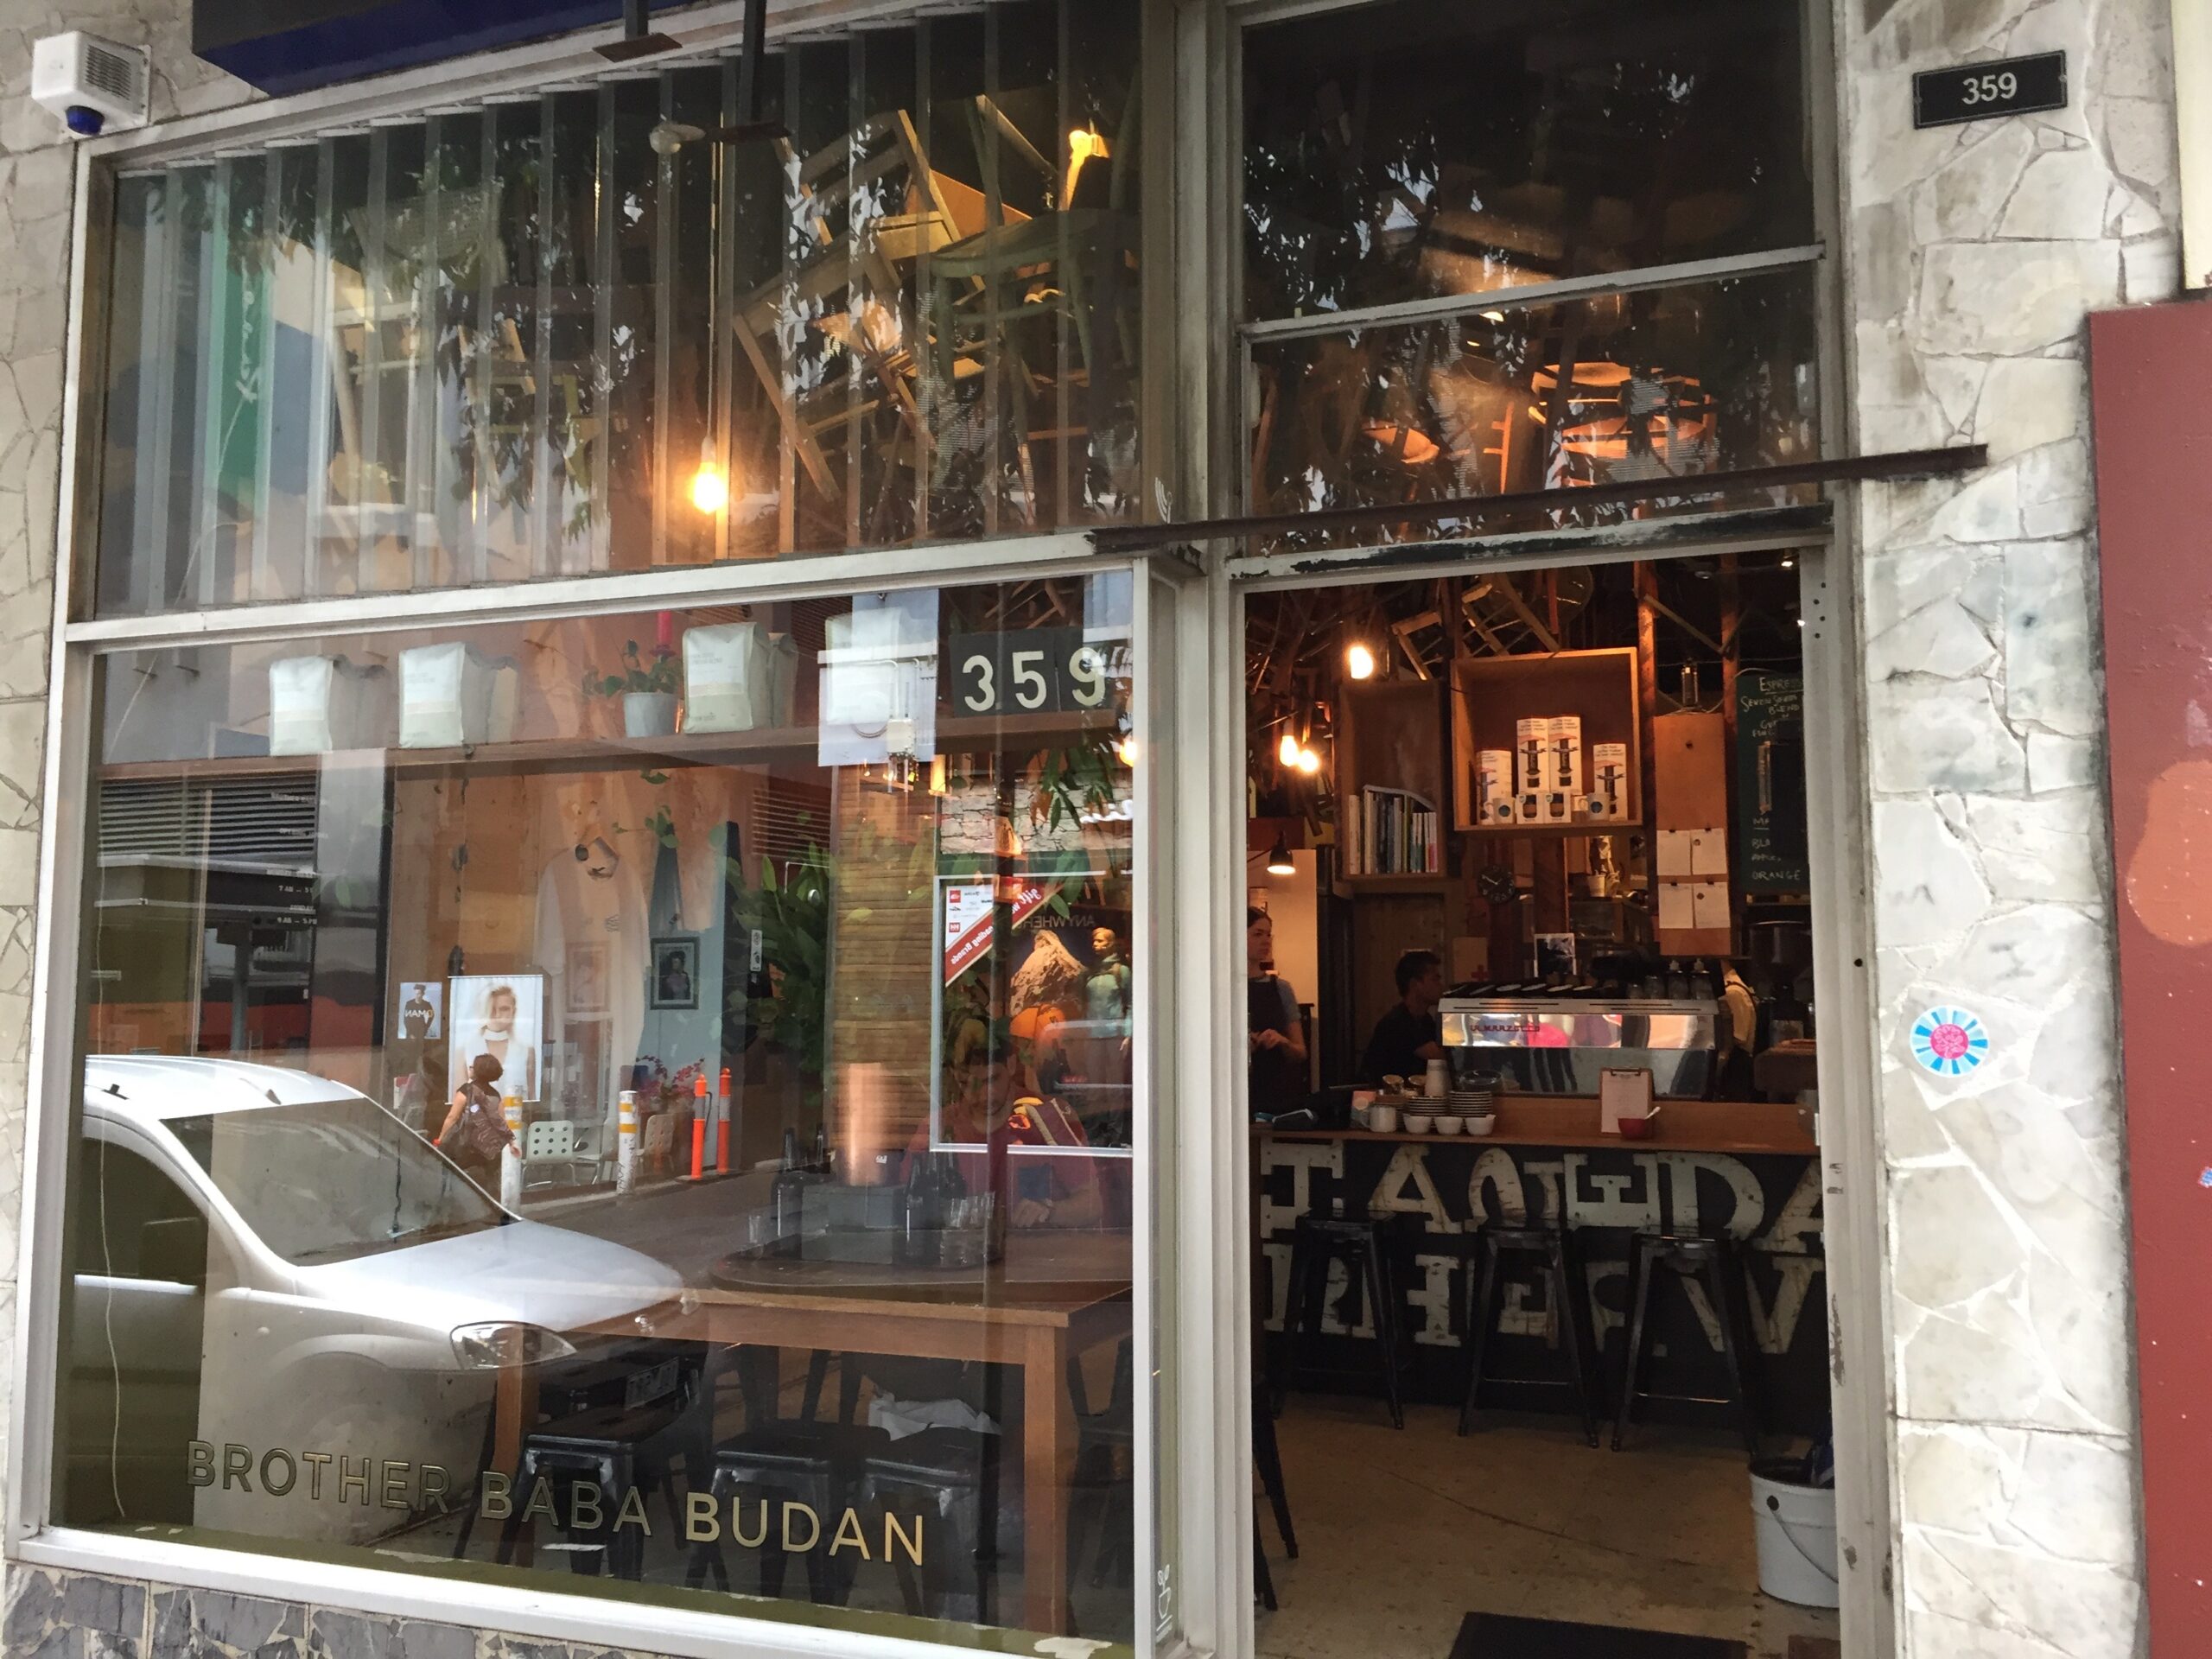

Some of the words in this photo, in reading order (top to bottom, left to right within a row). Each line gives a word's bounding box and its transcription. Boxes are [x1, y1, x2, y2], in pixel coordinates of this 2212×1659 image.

[1961, 73, 2017, 105] 359
[962, 647, 1106, 711] 359
[1751, 869, 1801, 880] ORANGE
[187, 1440, 450, 1515] BROTHER
[481, 1471, 652, 1536] BABA
[685, 1491, 923, 1567] BUDAN
